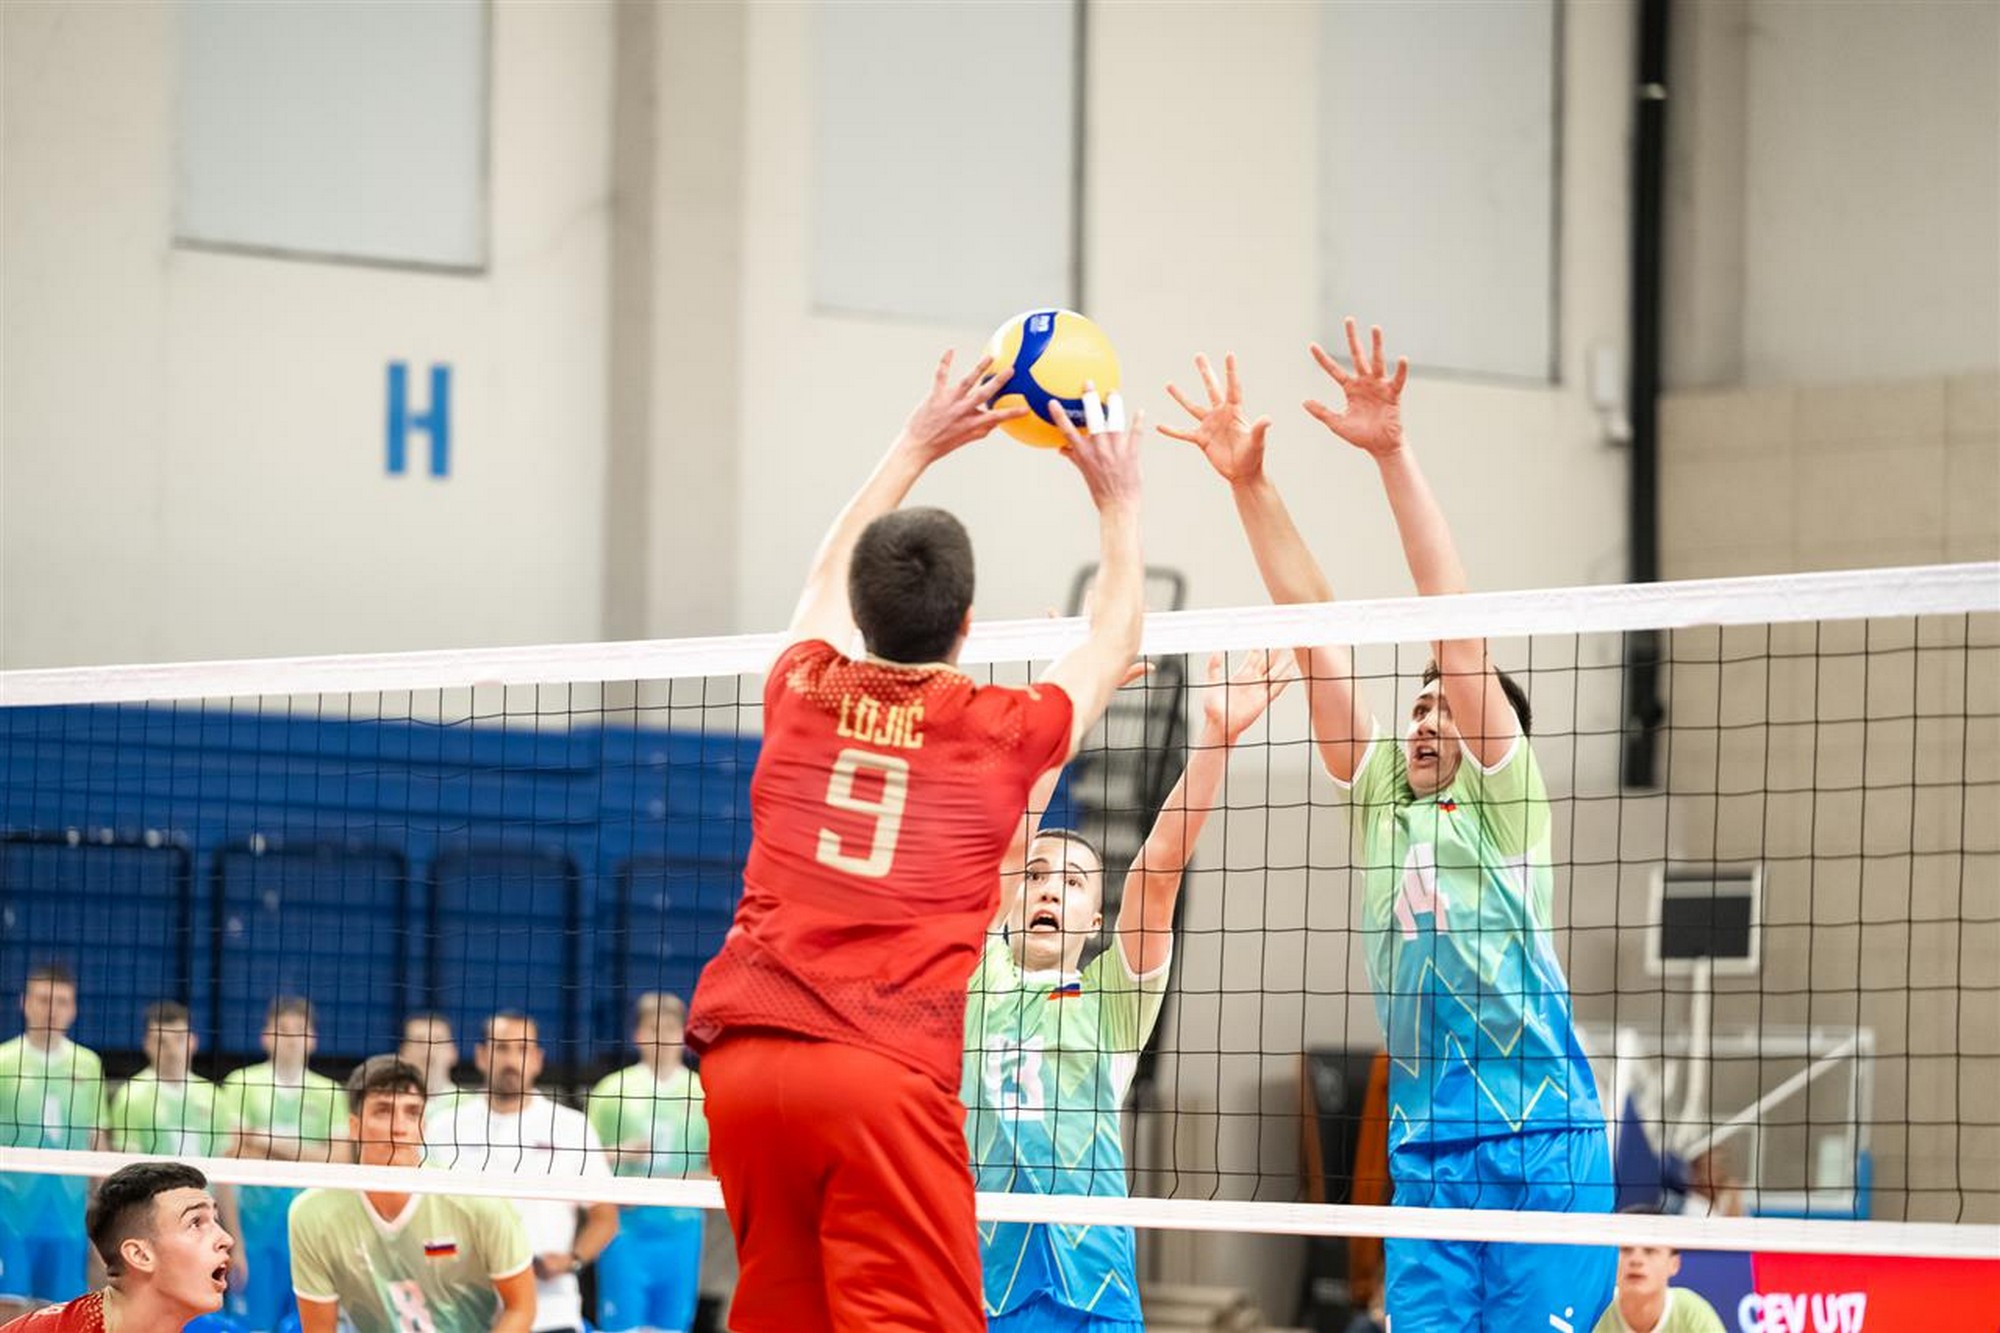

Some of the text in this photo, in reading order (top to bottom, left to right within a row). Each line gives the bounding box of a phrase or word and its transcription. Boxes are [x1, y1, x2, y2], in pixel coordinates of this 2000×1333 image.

[385, 359, 451, 478] H
[836, 693, 925, 749] LOJIĆ
[815, 747, 910, 878] 9
[1393, 843, 1450, 941] 4
[985, 1034, 1045, 1121] 13
[1738, 1291, 1868, 1333] CEV U17
